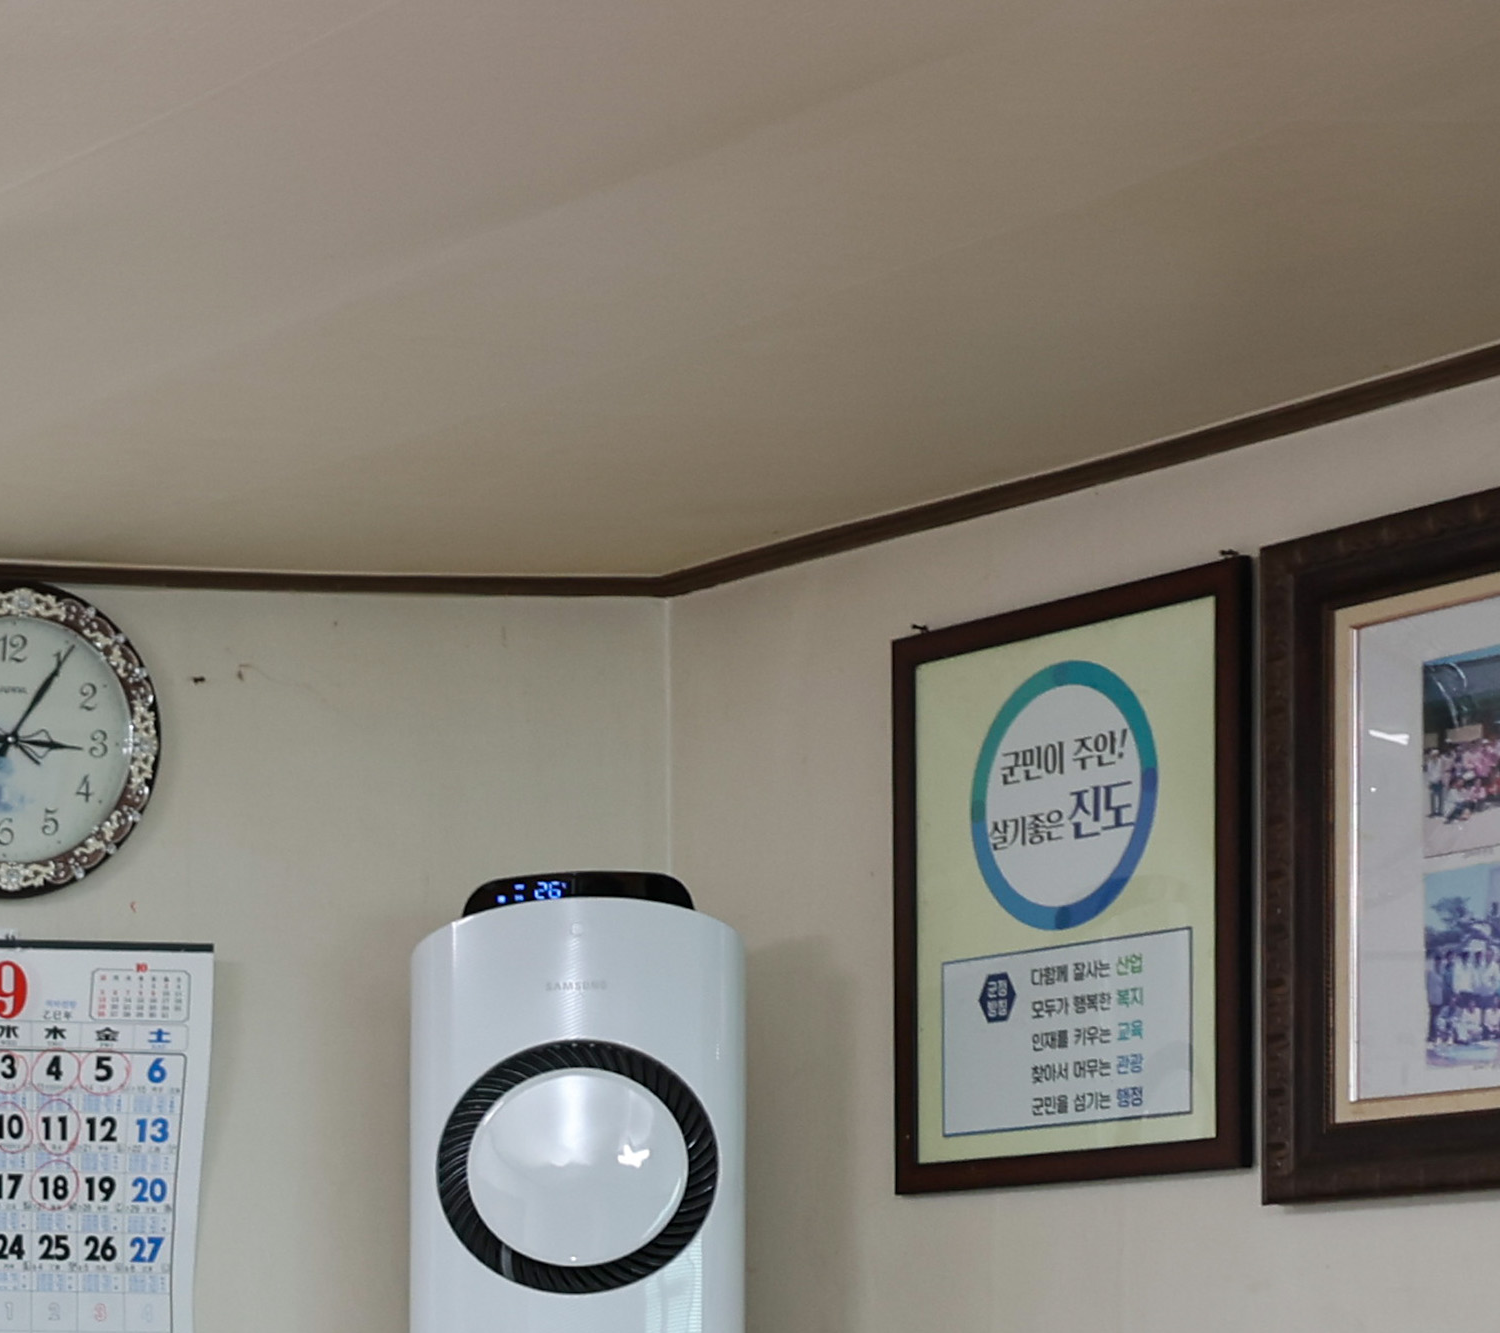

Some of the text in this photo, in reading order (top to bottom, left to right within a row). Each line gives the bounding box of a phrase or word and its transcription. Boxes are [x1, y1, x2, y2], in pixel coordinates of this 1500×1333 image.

[79, 683, 97, 711] 2
[89, 729, 108, 757] 3
[1001, 741, 1064, 785] 군민이
[76, 774, 93, 803] 4
[42, 809, 58, 836] 5
[990, 780, 1135, 851] 살기좋은 진도
[1031, 954, 1143, 986] 다함께 잘사는 산업
[546, 981, 607, 991] SAMSUNG
[1032, 988, 1143, 1019] 모두가 행복한 복지
[95, 1027, 119, 1042] 金
[148, 1029, 172, 1043] 土
[1032, 1020, 1143, 1052] 인재를 키우는 교육
[1, 1054, 17, 1079] 3
[46, 1055, 62, 1080] 4
[95, 1057, 113, 1082] 5
[147, 1058, 167, 1083] 6
[1032, 1054, 1143, 1084] 찾아서 머무는 관광
[1032, 1087, 1143, 1116] 군민을 섬기는 행정
[42, 1116, 68, 1141] 11
[86, 1117, 117, 1142] 12
[136, 1118, 169, 1143] 13
[40, 1175, 69, 1200] 18
[86, 1177, 116, 1202] 19
[132, 1178, 167, 1203] 20
[39, 1235, 70, 1261] 25
[84, 1236, 117, 1262] 26
[130, 1237, 164, 1262] 27
